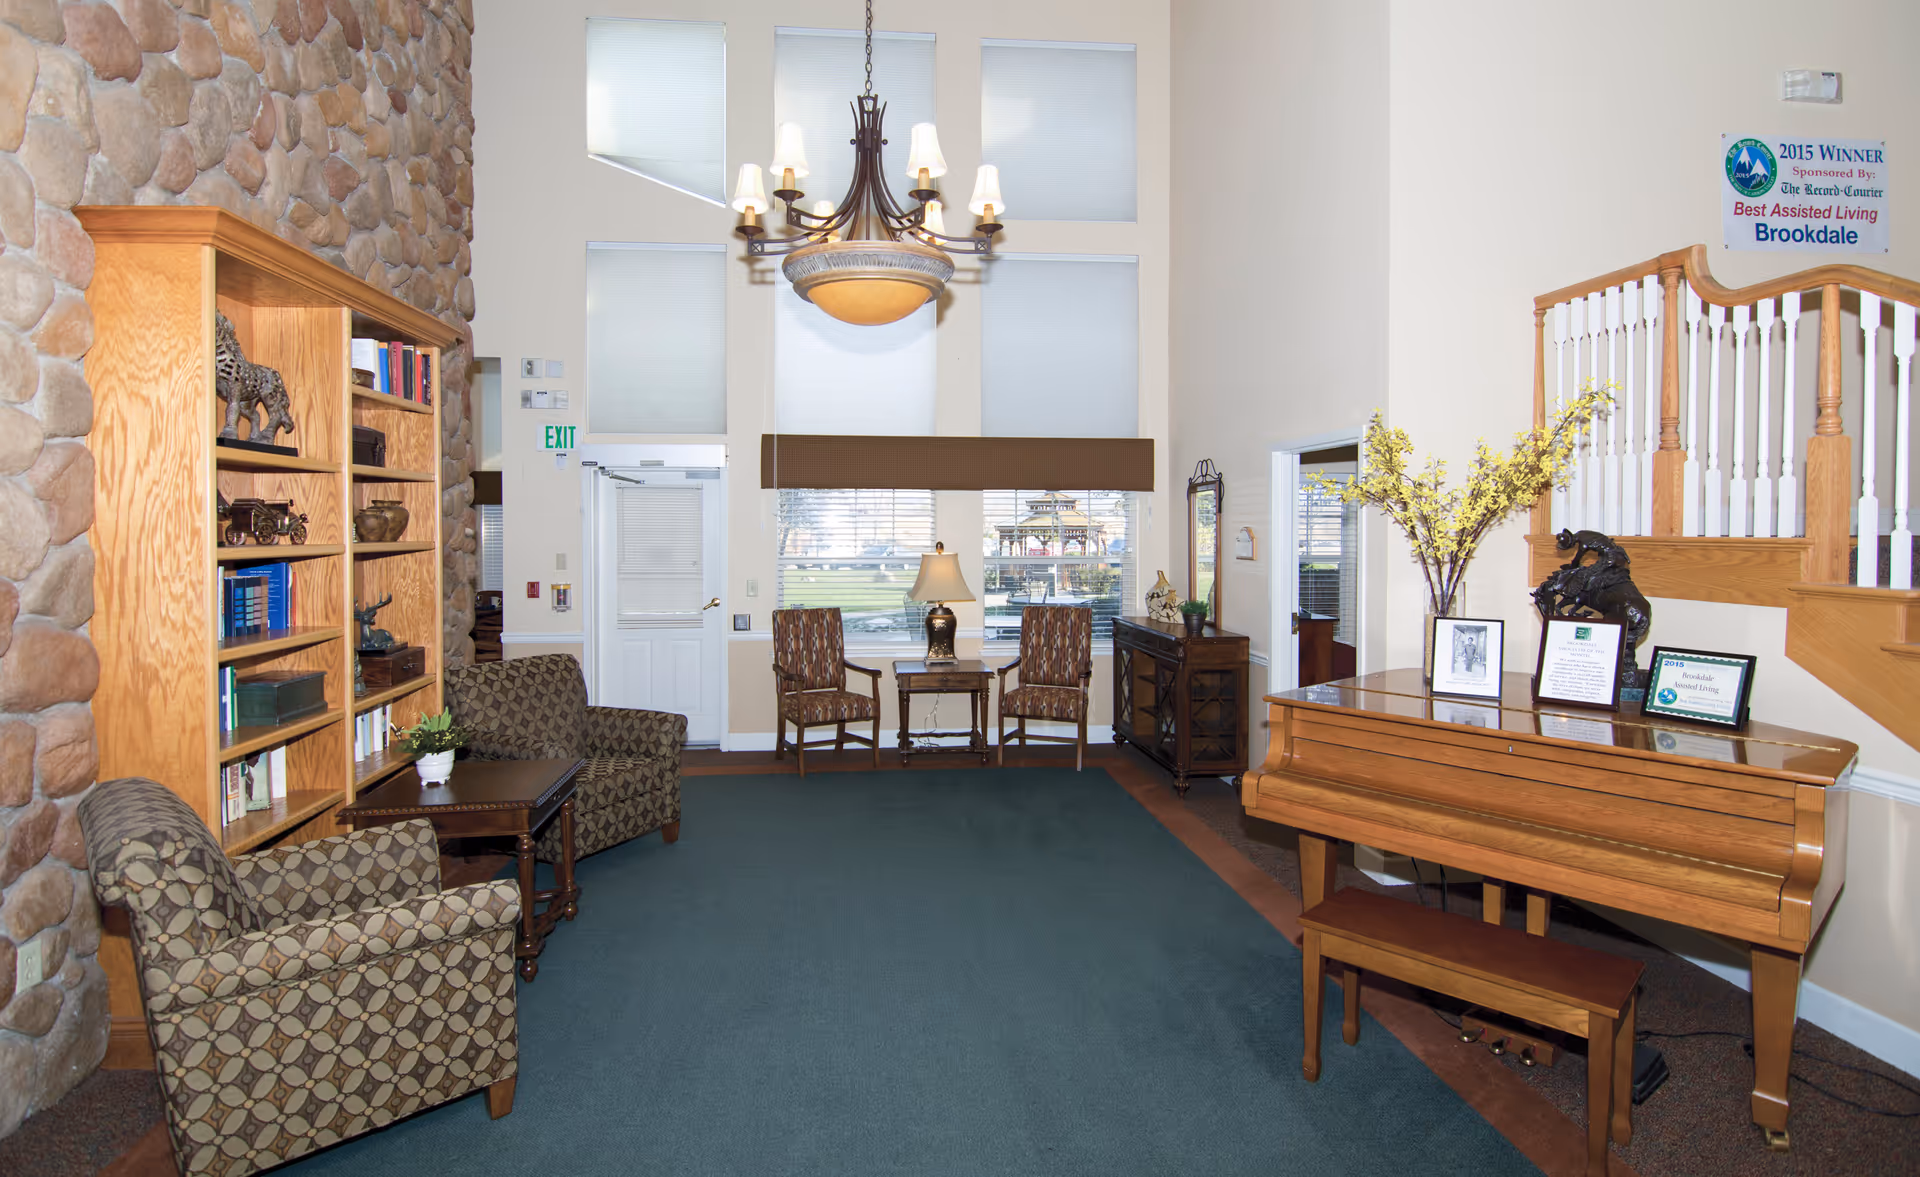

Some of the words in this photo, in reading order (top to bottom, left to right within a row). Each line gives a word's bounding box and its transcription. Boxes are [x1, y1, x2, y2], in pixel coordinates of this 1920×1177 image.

[1780, 143, 1814, 160] 2015
[1819, 144, 1884, 163] WINNER
[1792, 166, 1853, 179] Sponsored
[1858, 168, 1876, 181] By:
[1781, 182, 1800, 197] The
[1804, 184, 1884, 198] Record-Courier
[1733, 201, 1767, 217] Best
[1770, 202, 1832, 219] Assisted
[1836, 206, 1878, 224] Living
[1755, 222, 1858, 244] Brookdale
[545, 425, 576, 448] EXIT
[1664, 660, 1684, 668] 2015
[1682, 672, 1714, 682] Brookdale
[1673, 681, 1698, 690] Assisted
[1698, 684, 1720, 694] Living
